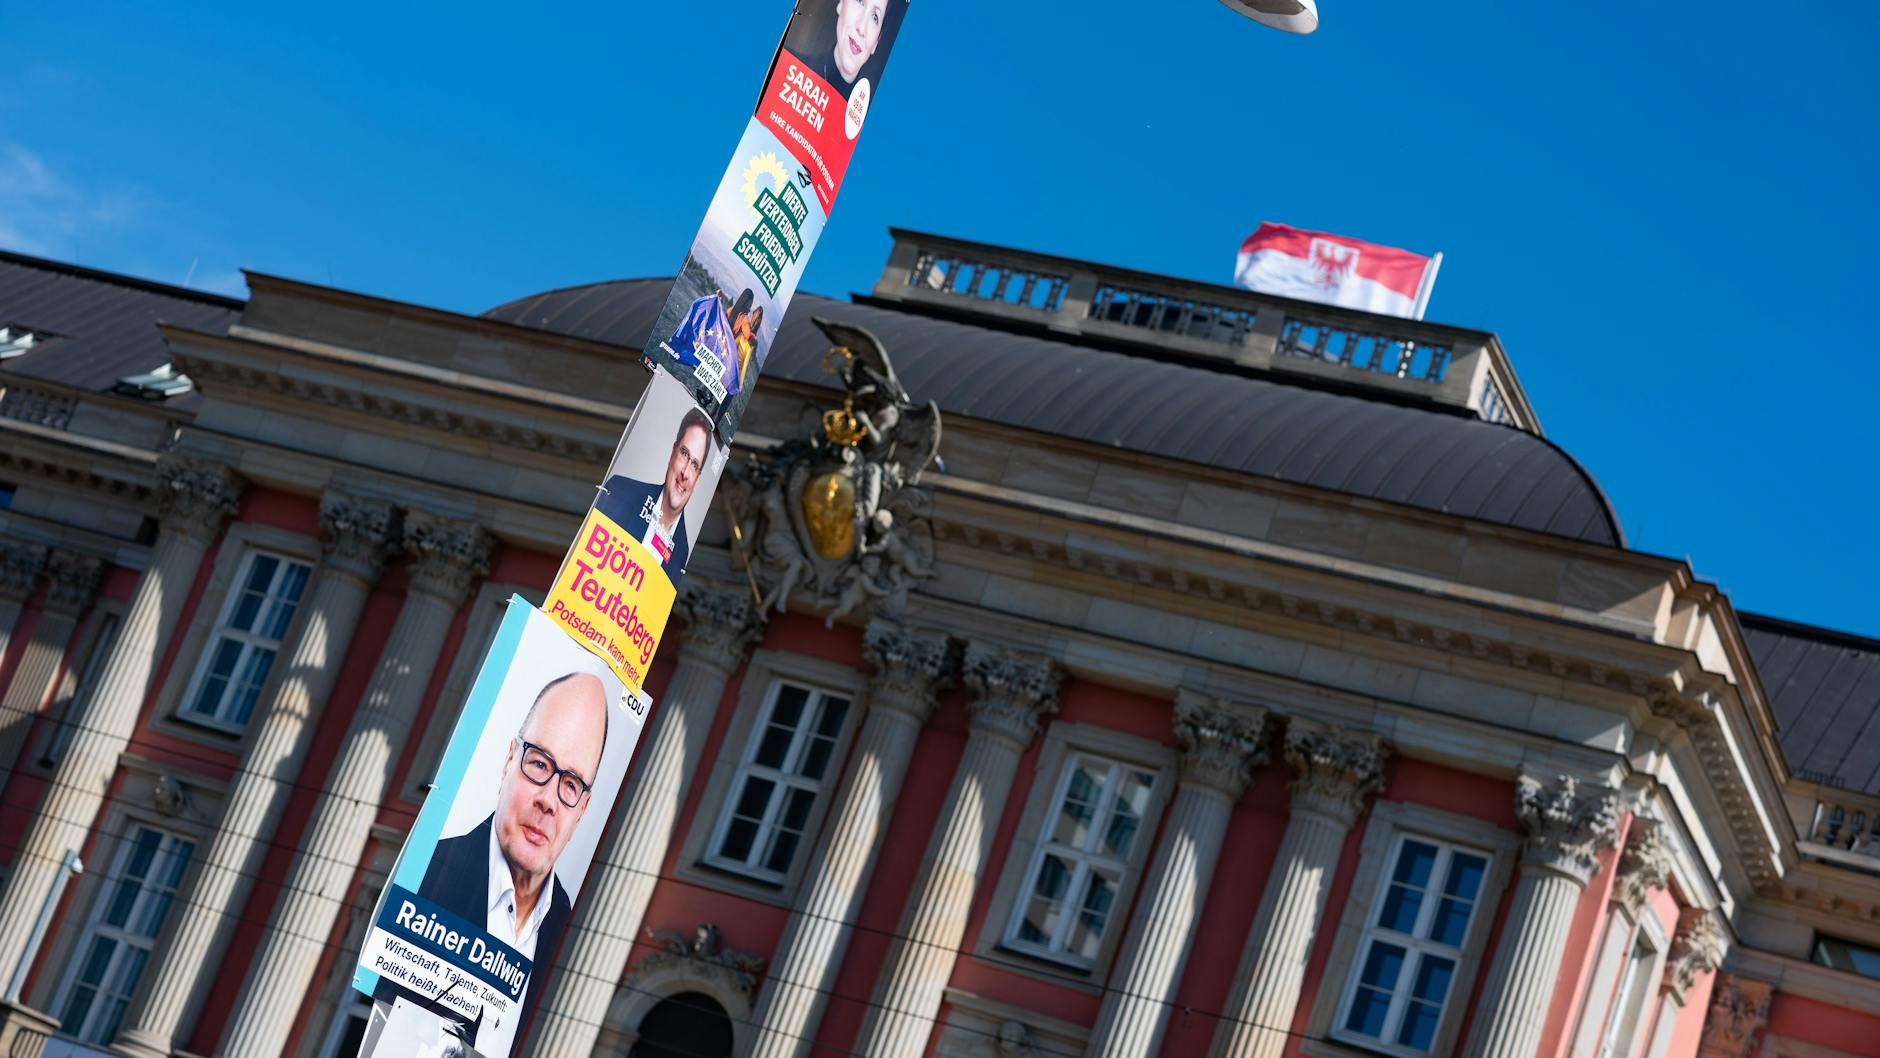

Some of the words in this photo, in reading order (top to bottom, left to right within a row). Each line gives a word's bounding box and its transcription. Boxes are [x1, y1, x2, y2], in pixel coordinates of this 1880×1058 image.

[778, 82, 825, 132] ZALFEN
[786, 65, 830, 111] SARAH
[769, 111, 787, 129] IHRE
[785, 124, 818, 160] KANDIDATIN
[782, 186, 806, 225] WERTE
[755, 223, 788, 269] FRIEDEN
[696, 366, 712, 383] WAS
[697, 346, 723, 377] MACHEN,
[584, 523, 645, 592] Björn
[551, 600, 607, 647] Potsdam
[607, 638, 624, 664] kann
[570, 559, 655, 665] Teuteberg
[627, 694, 644, 716] CDU
[384, 937, 441, 977] Wirtschaft,
[444, 967, 479, 998] Talente,
[395, 899, 469, 955] Rainer
[468, 937, 526, 996] Dallwig
[375, 955, 407, 981] Politik
[408, 974, 436, 995] heißt
[437, 987, 479, 1016] machen!
